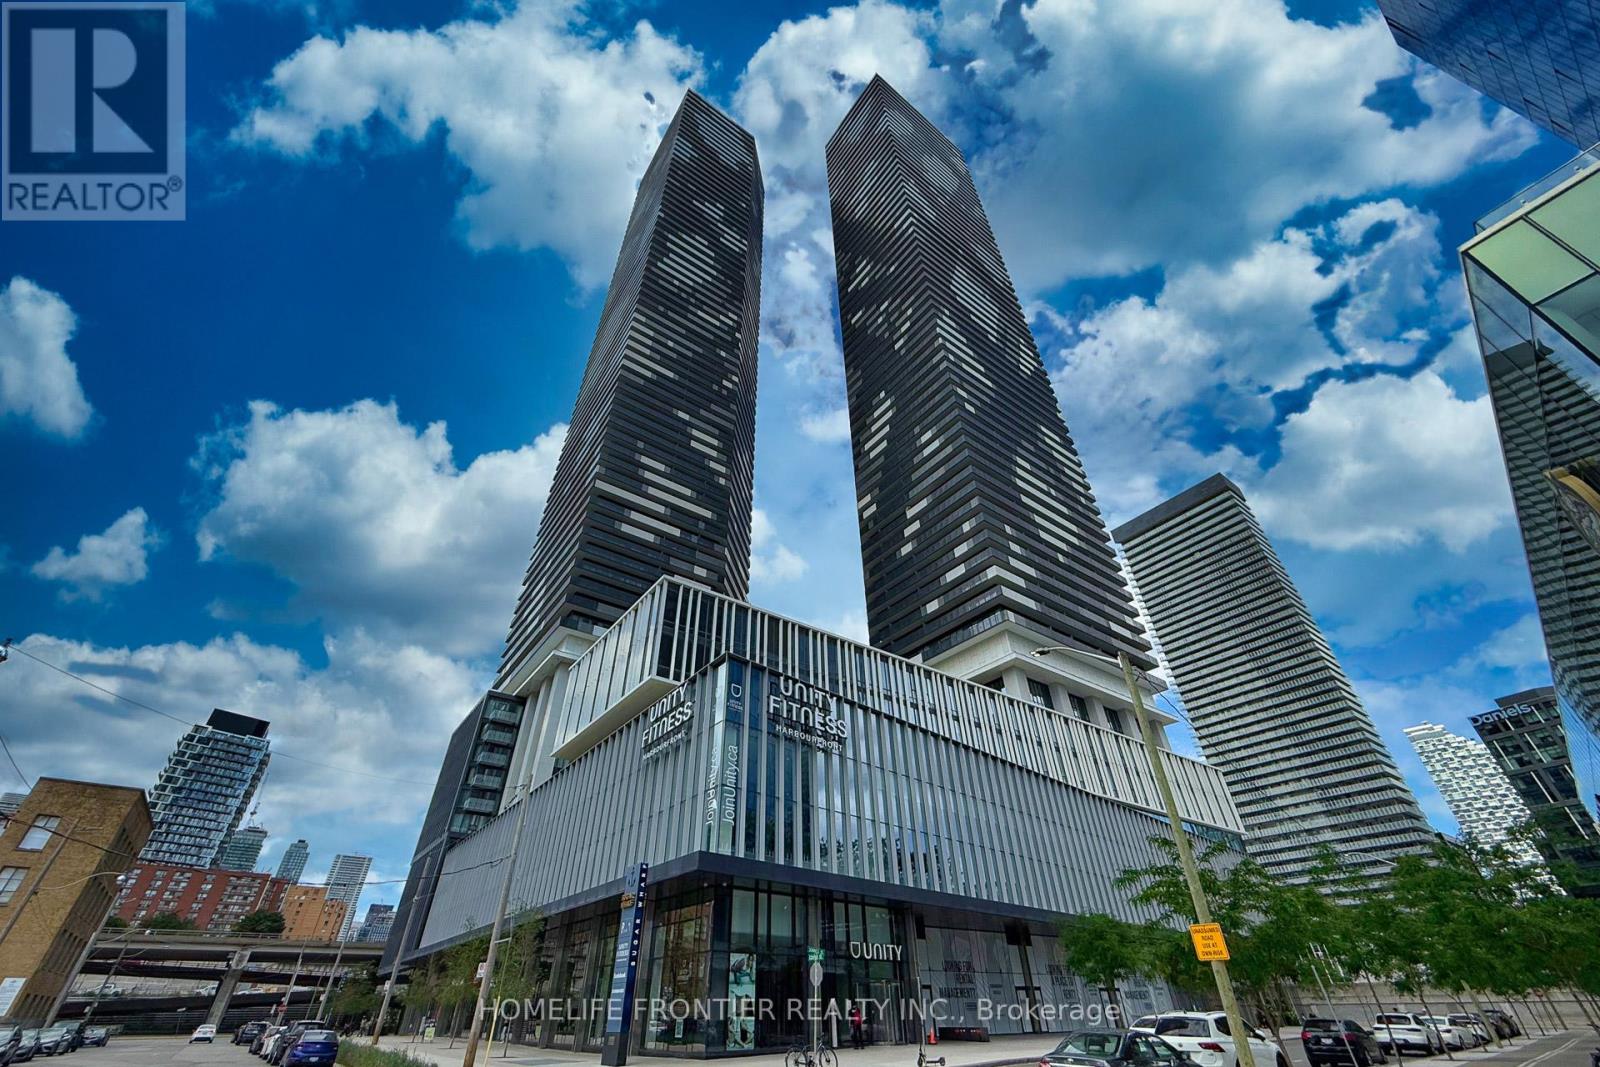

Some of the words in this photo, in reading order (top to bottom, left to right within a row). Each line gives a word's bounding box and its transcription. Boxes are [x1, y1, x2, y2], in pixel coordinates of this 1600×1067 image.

[650, 682, 688, 722] UNITY
[779, 676, 837, 711] UNITY
[641, 701, 693, 748] FITNESS
[769, 695, 847, 738] FITNESS
[1471, 703, 1531, 726] Daniels
[723, 745, 739, 826] JoinUnity.ca
[863, 942, 902, 961] UNITY
